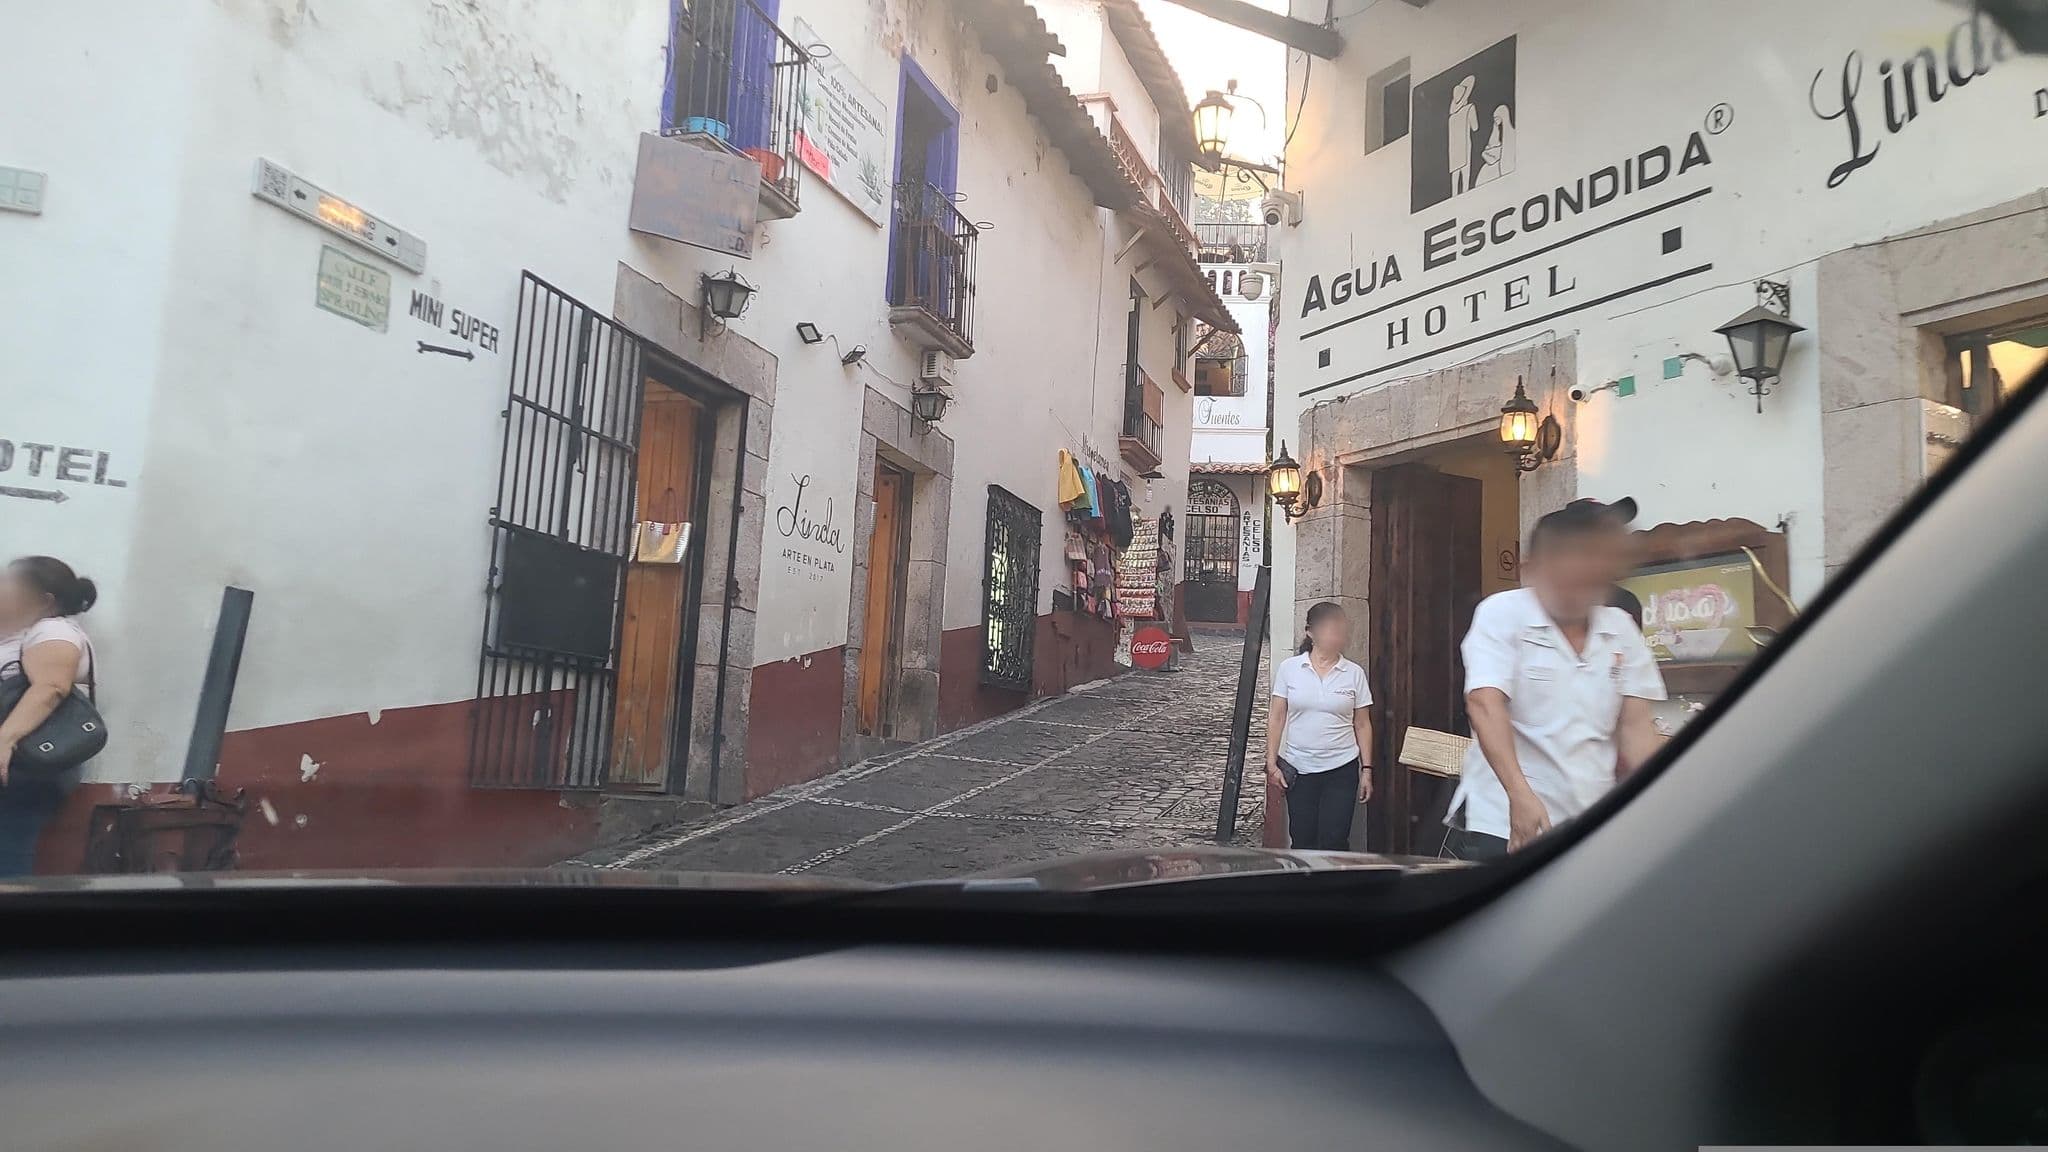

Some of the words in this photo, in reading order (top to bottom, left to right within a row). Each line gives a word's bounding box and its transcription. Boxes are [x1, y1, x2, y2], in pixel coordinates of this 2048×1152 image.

[1301, 254, 1402, 319] AGUA
[1386, 264, 1577, 350] HOTEL
[410, 289, 444, 329] MINI
[450, 308, 499, 354] SUPER
[776, 472, 845, 553] Linda
[1252, 519, 1261, 553] CELSO
[782, 548, 801, 563] ARTE
[802, 554, 813, 567] EN
[814, 557, 835, 572] PLATA
